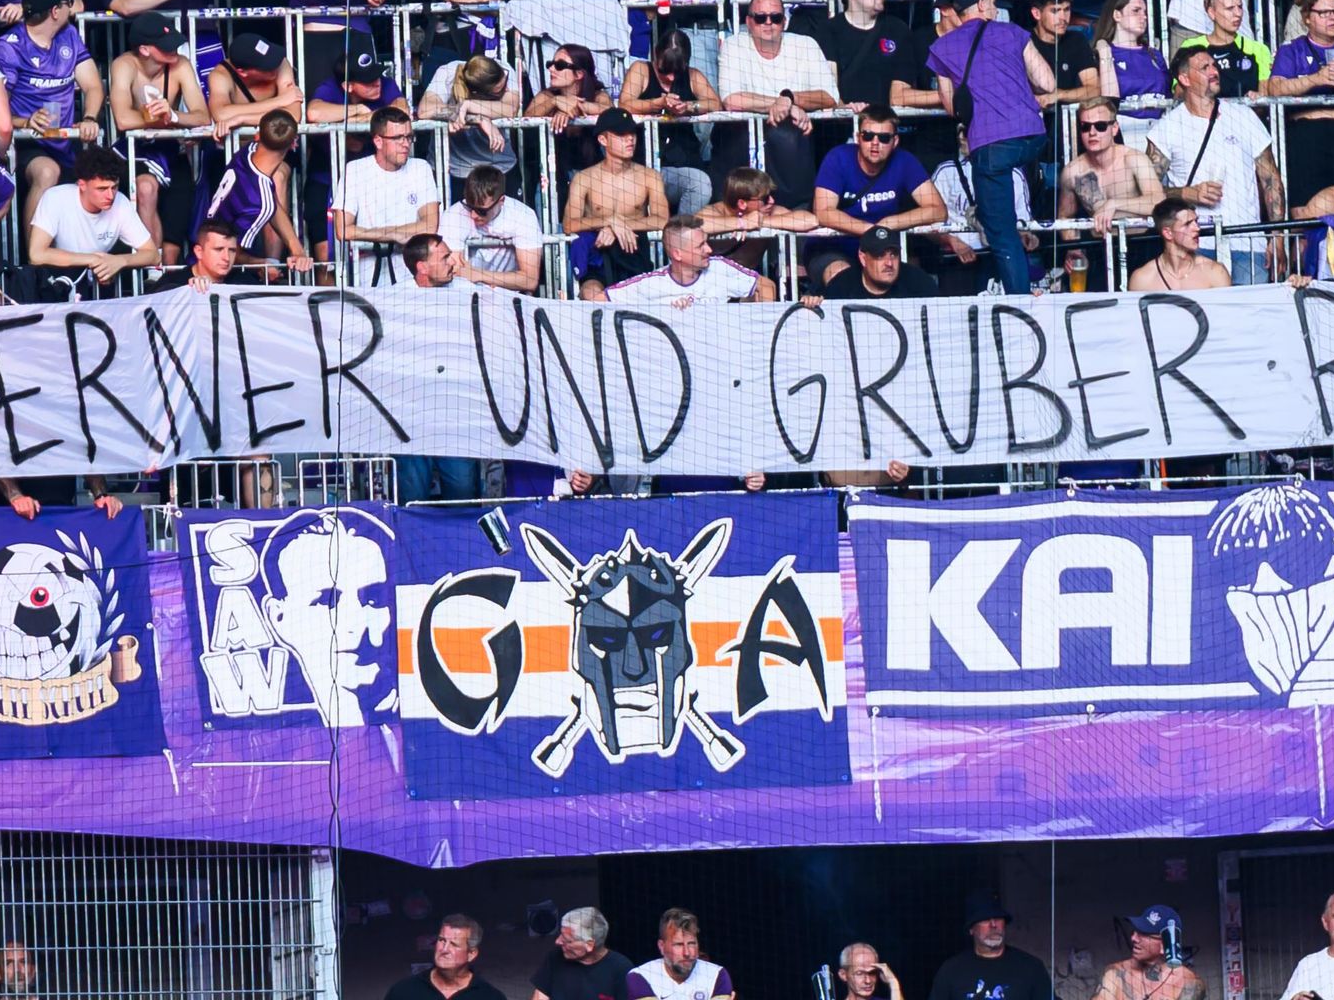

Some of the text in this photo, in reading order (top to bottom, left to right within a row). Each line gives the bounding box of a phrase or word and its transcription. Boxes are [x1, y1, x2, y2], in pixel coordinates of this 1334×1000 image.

[472, 292, 694, 473] UND
[768, 292, 1247, 464] GRUBER
[416, 554, 834, 736] G A
[885, 534, 1194, 673] KAI
